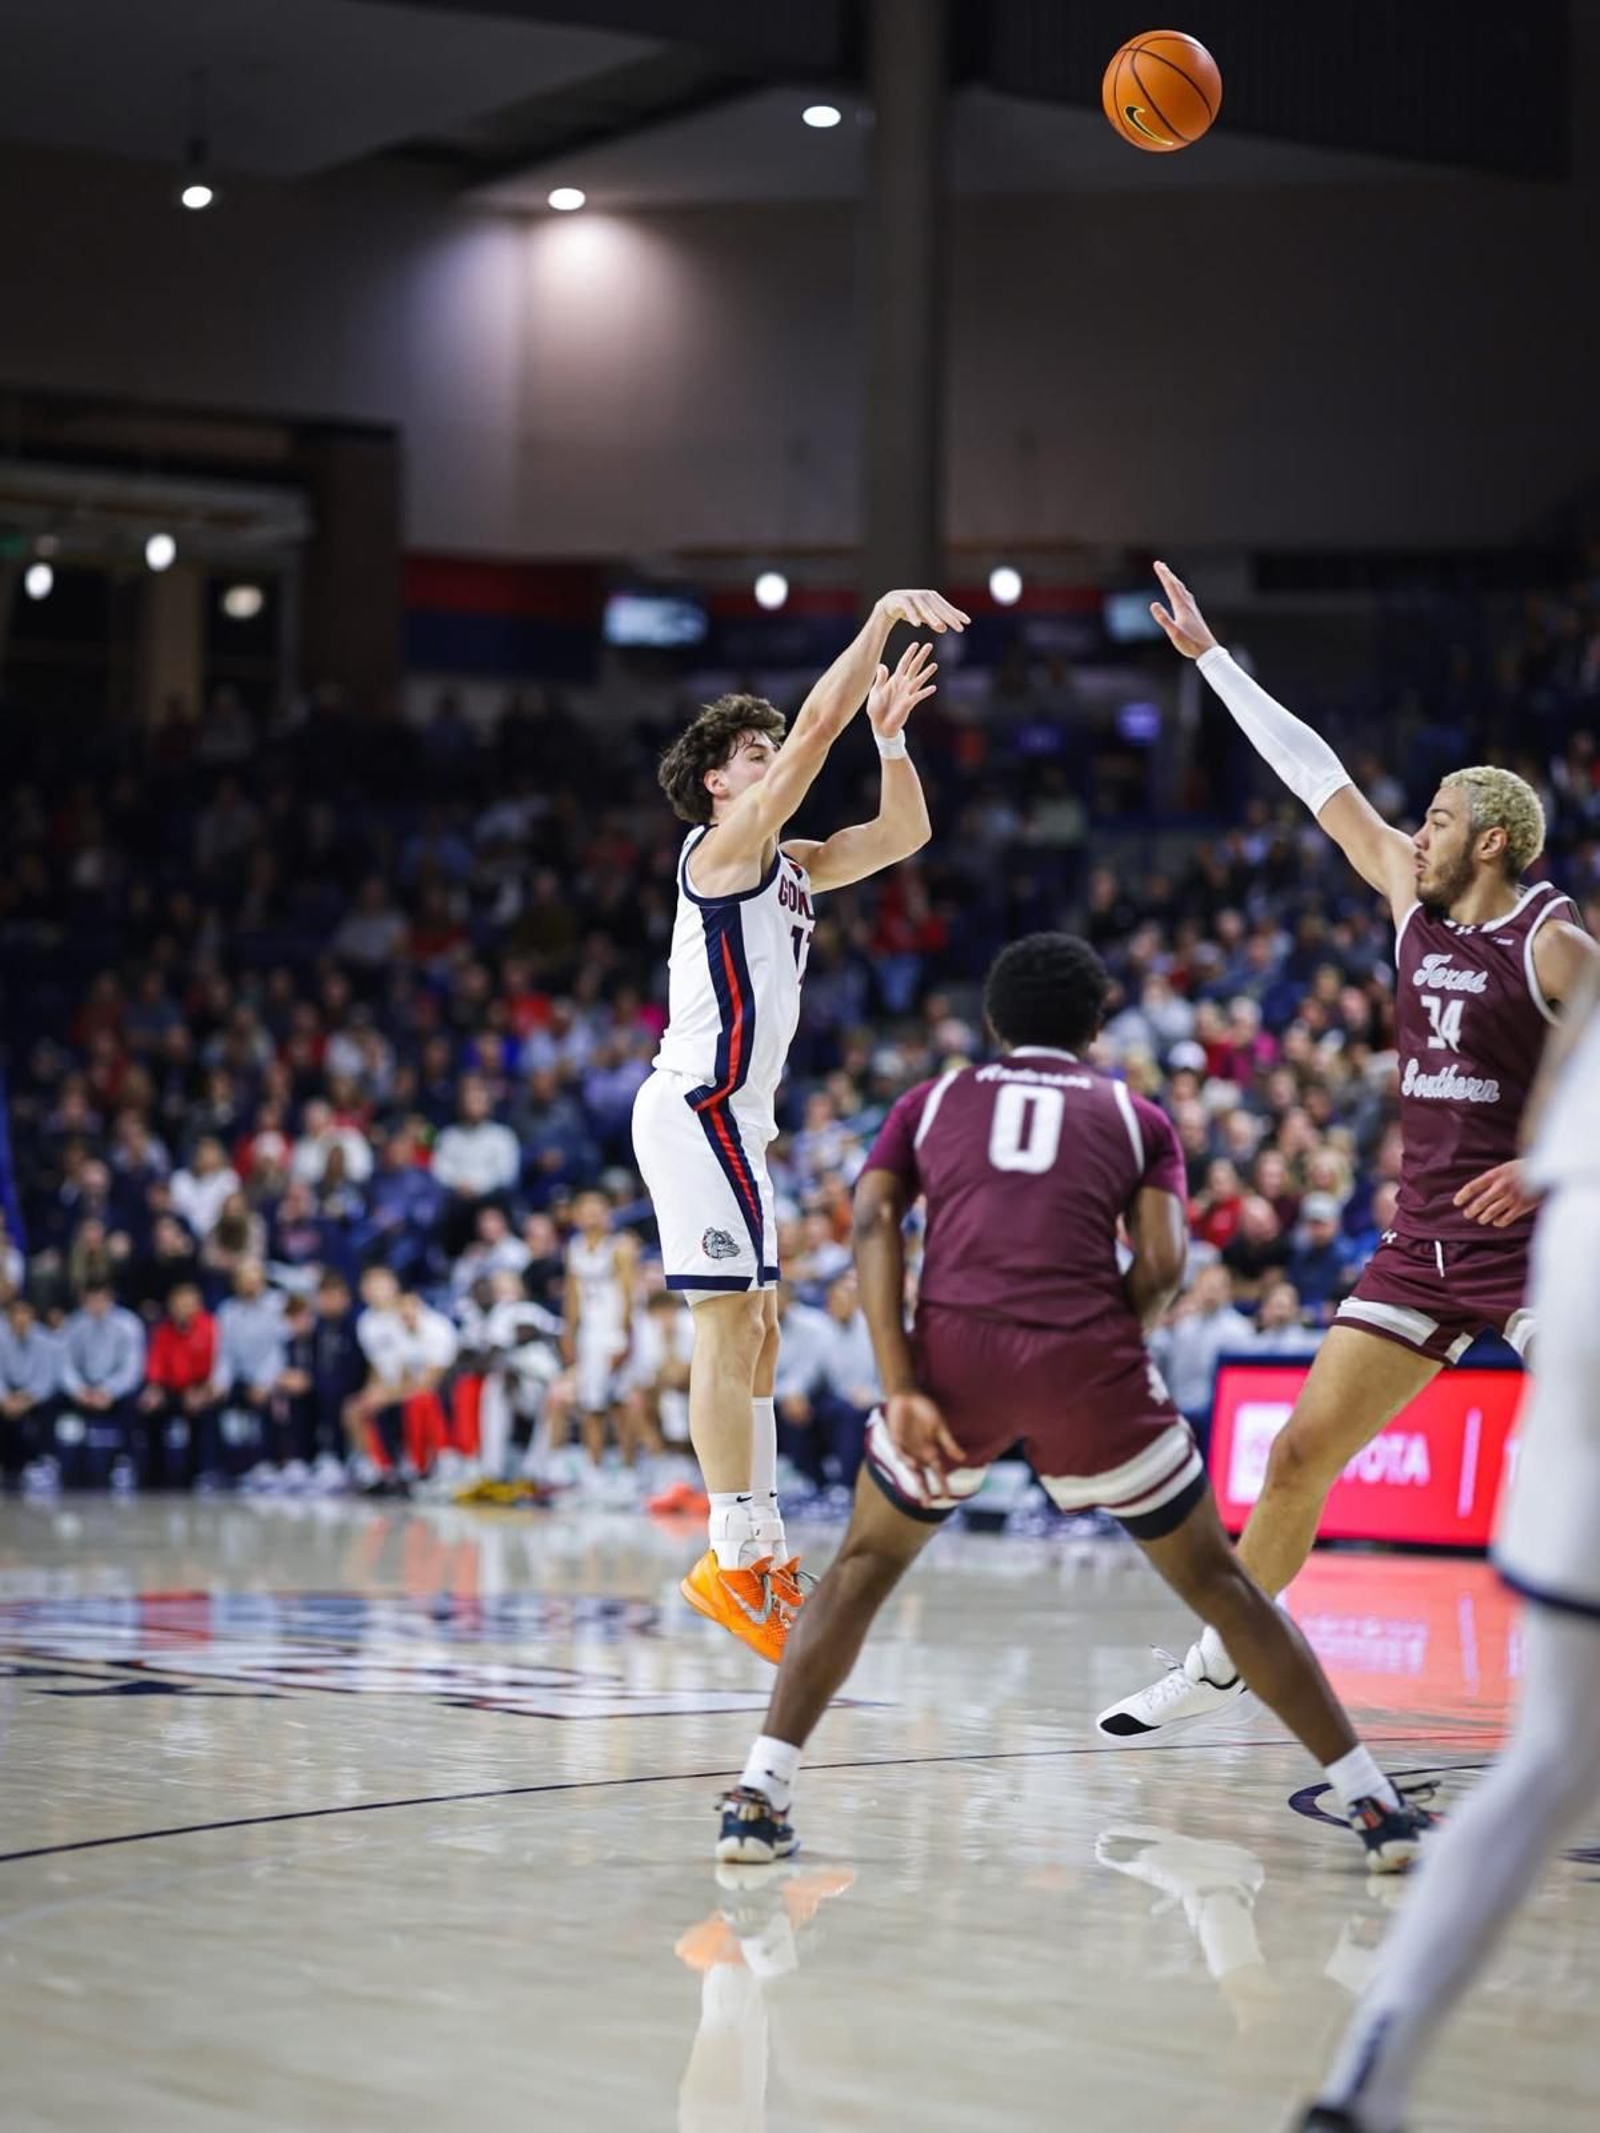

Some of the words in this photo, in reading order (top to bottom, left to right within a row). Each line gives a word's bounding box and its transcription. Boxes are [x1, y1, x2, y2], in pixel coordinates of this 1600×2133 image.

[1413, 953, 1488, 993] Texas
[1420, 995, 1465, 1053] 34
[1401, 1057, 1500, 1103] Southern
[988, 1083, 1065, 1174] 0
